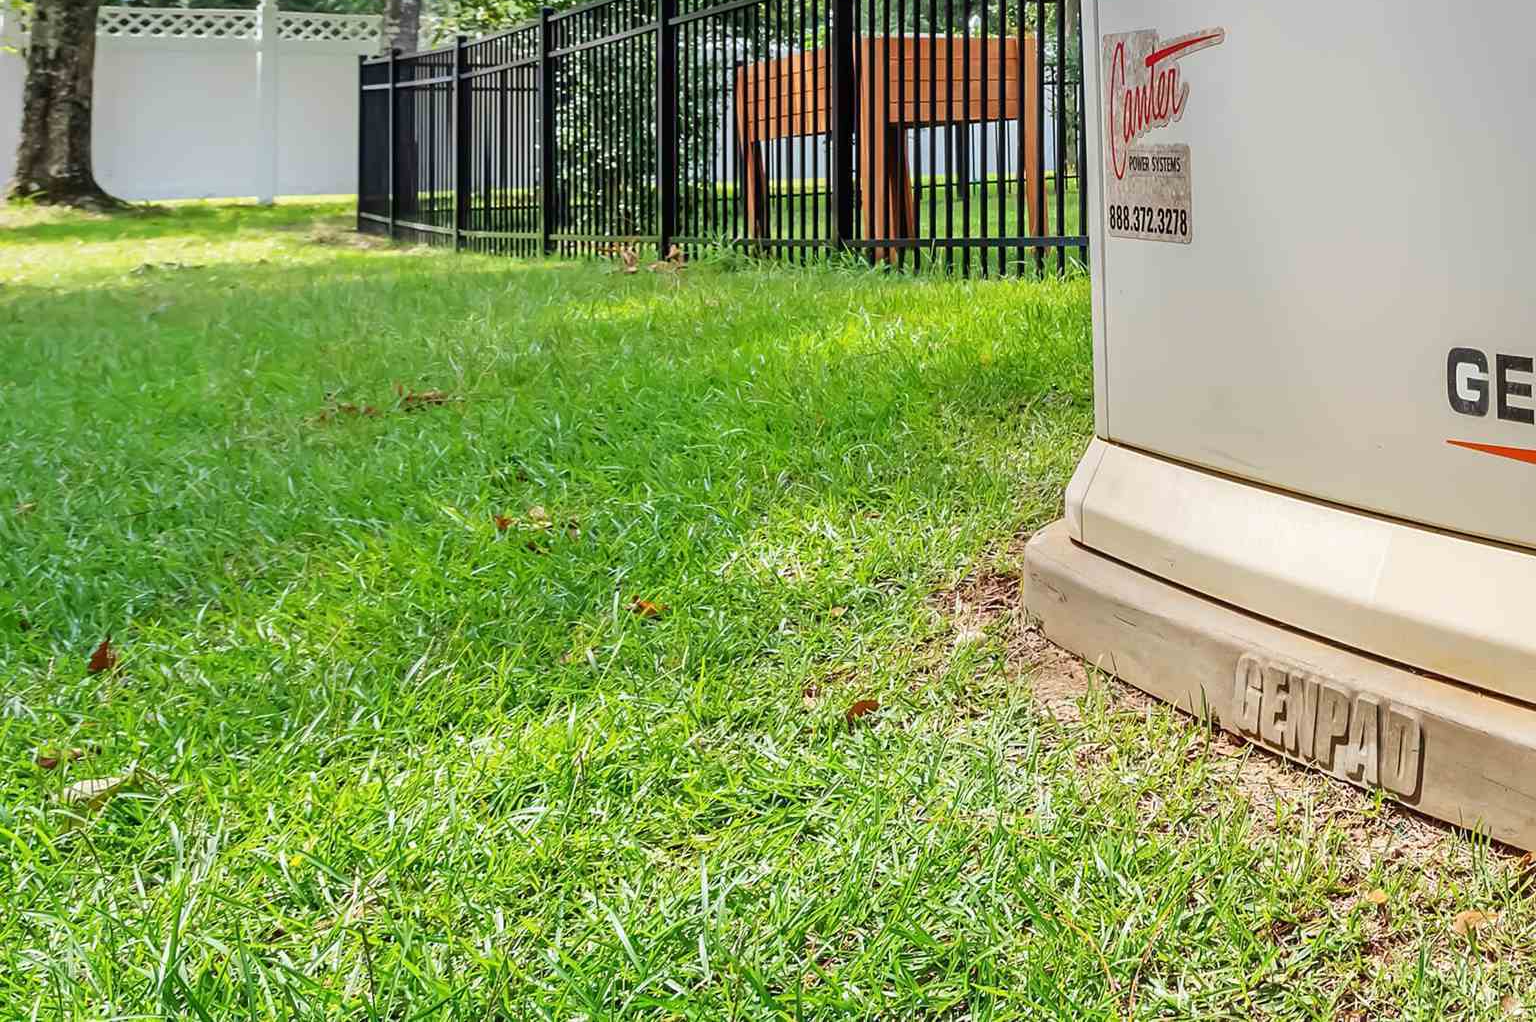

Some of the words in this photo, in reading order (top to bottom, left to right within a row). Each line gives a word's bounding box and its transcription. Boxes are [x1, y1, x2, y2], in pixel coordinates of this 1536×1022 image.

[1128, 155, 1150, 172] POWER
[1151, 156, 1181, 172] SYSTEMS
[1109, 205, 1188, 236] 888.372.3278
[1234, 652, 1426, 806] GENPAD
